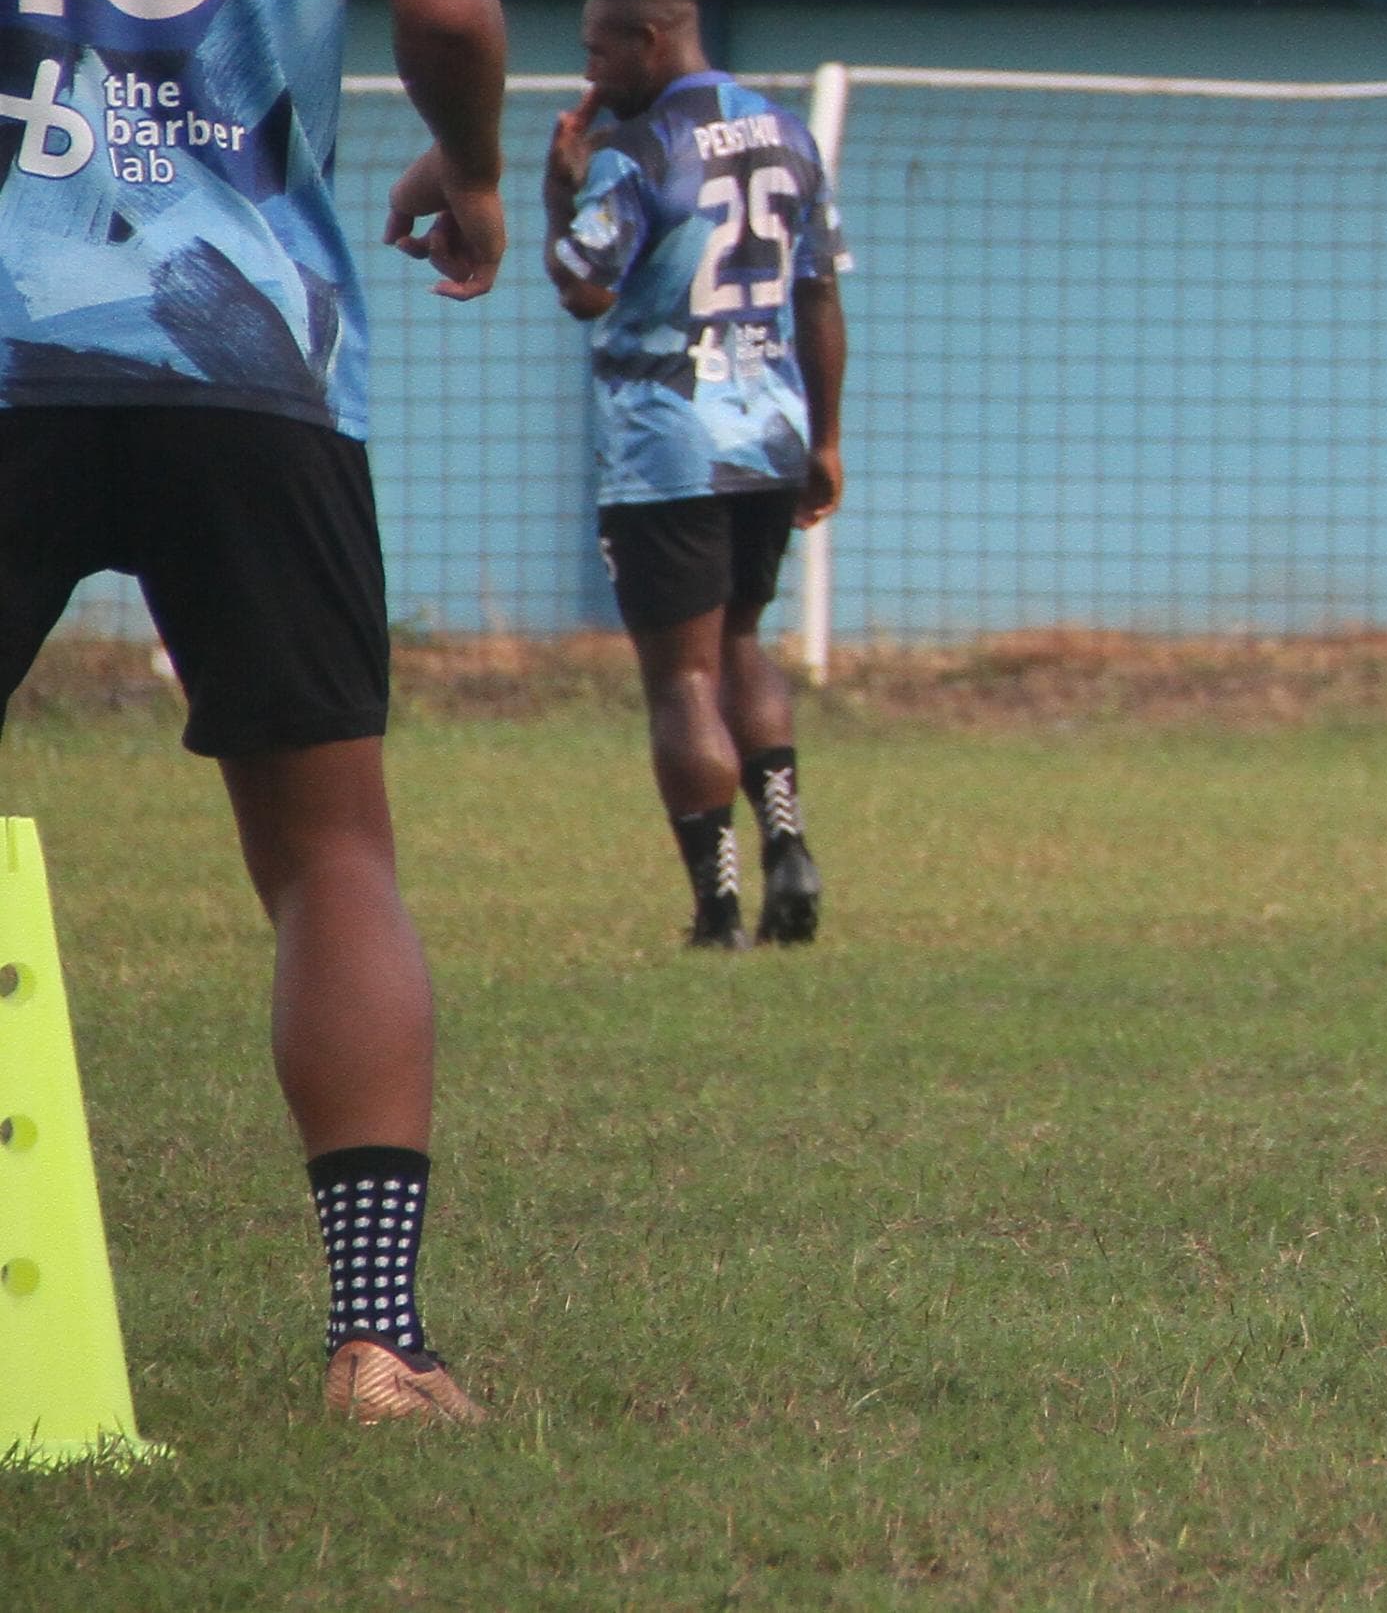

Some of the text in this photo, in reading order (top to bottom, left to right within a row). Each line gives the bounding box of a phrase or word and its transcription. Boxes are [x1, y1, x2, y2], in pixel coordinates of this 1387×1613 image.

[104, 72, 181, 109] the
[106, 109, 245, 151] barber
[108, 146, 175, 183] lab
[690, 165, 799, 317] 25
